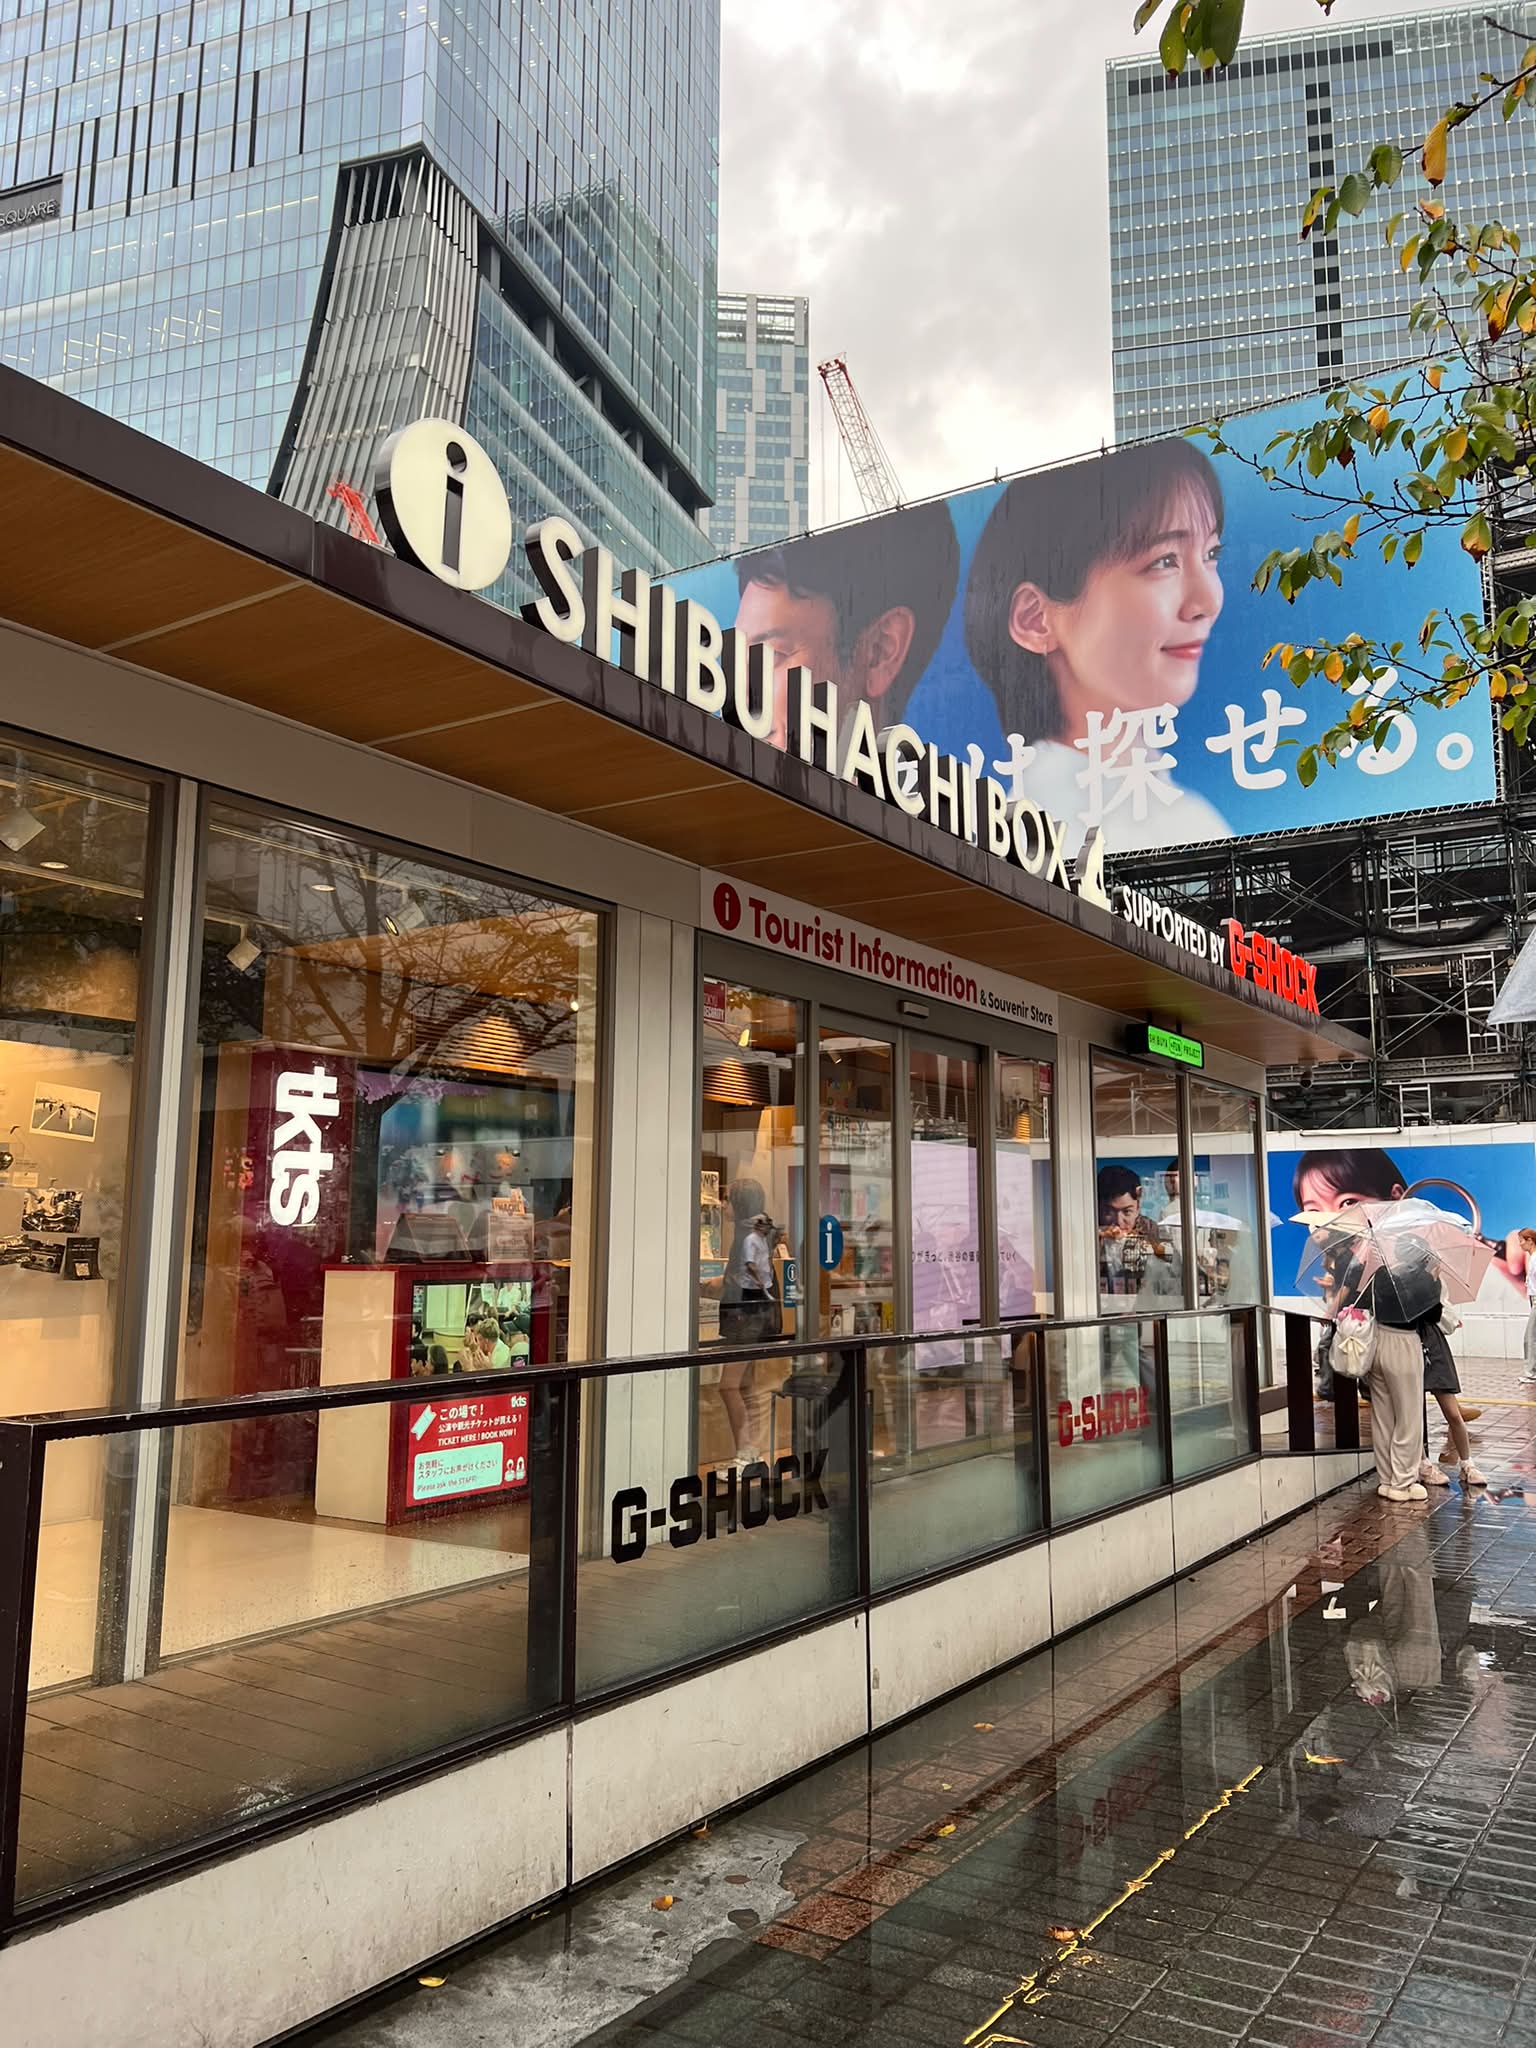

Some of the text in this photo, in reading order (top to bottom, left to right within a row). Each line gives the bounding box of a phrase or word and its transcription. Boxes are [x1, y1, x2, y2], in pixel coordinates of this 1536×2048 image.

[0, 199, 55, 227] SQUARE
[521, 516, 1071, 892] SHIBU HACHI BOX
[749, 897, 1054, 1027] Tourist Information & Souvenir Store
[1121, 885, 1320, 1016] SUPPORTED BY G-SHOCK
[269, 1066, 341, 1226] tkts
[438, 1436, 460, 1447] TICKET
[1058, 1384, 1151, 1448] G-SHOCK
[611, 1447, 829, 1564] G-SHOCK
